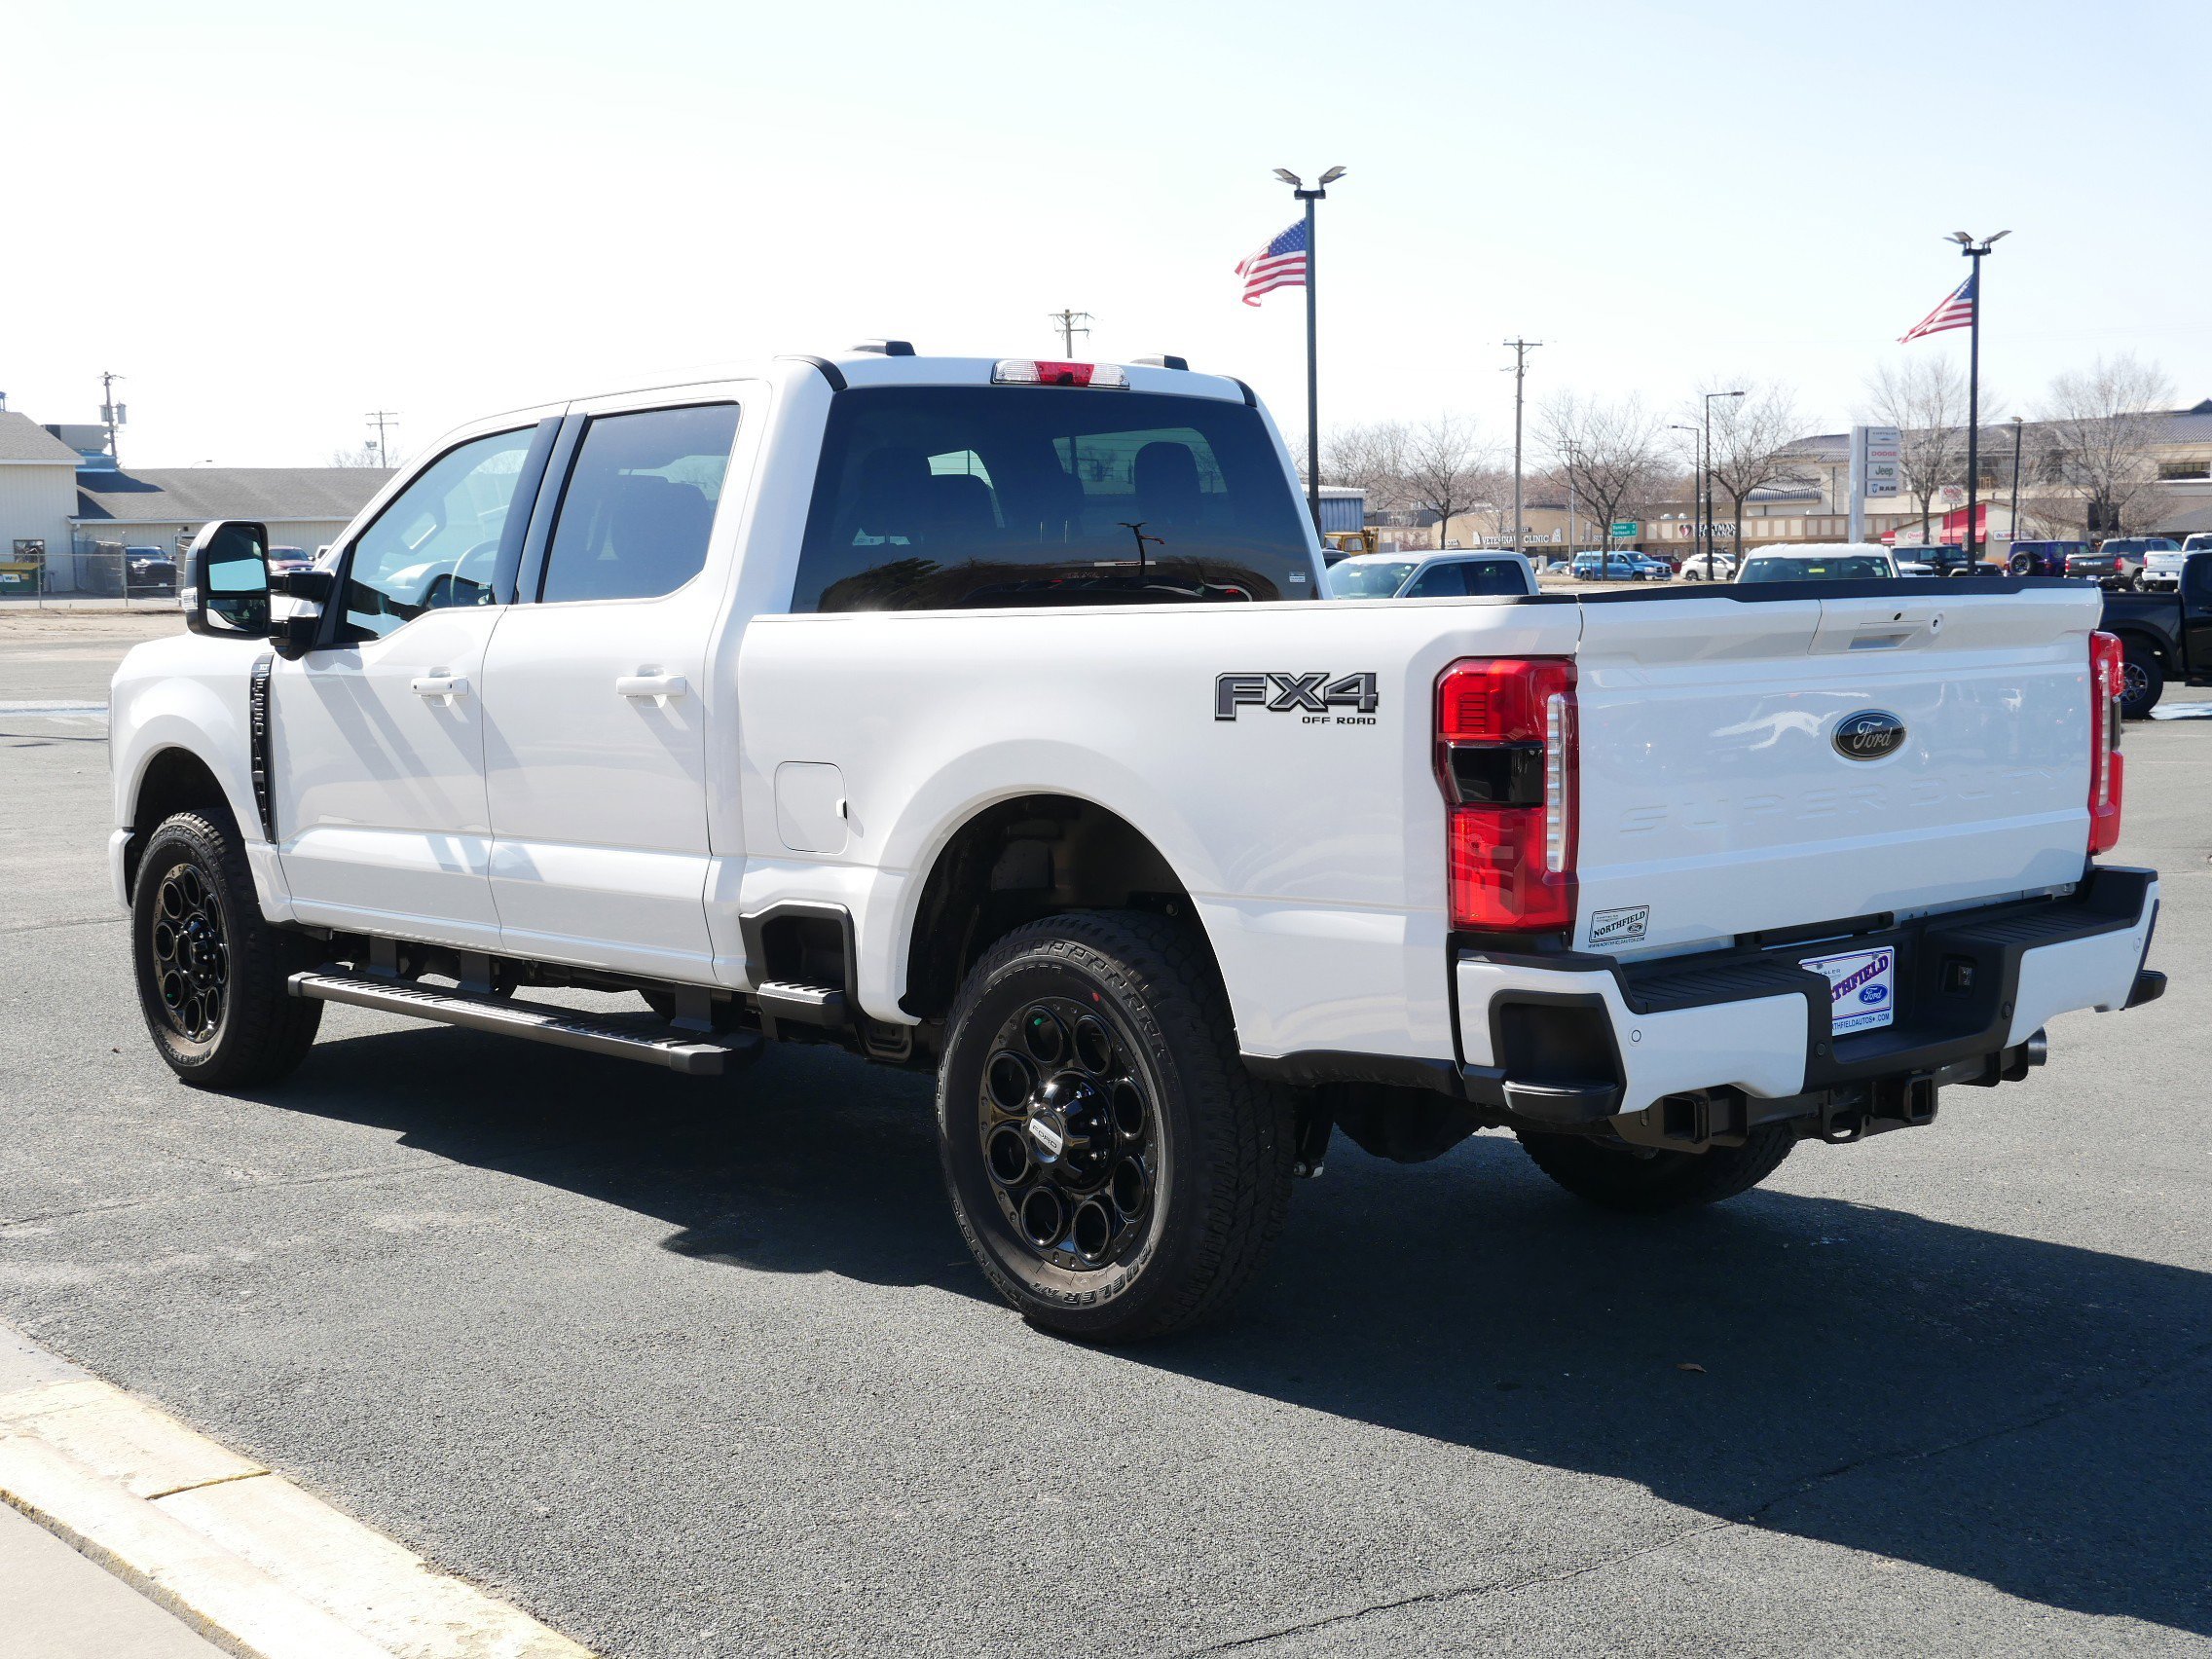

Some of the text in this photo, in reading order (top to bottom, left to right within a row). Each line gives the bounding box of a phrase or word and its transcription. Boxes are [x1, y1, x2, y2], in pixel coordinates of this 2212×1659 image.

[1875, 464, 1894, 477] Jeep
[1524, 535, 1549, 543] CLINIC
[1214, 672, 1378, 721] FX4
[1853, 721, 1894, 750] Ford
[1594, 911, 1646, 938] NORTHFIELD
[1863, 987, 1883, 1002] Ford
[1033, 1125, 1057, 1149] FORD
[1062, 1239, 1153, 1306] DUELER
